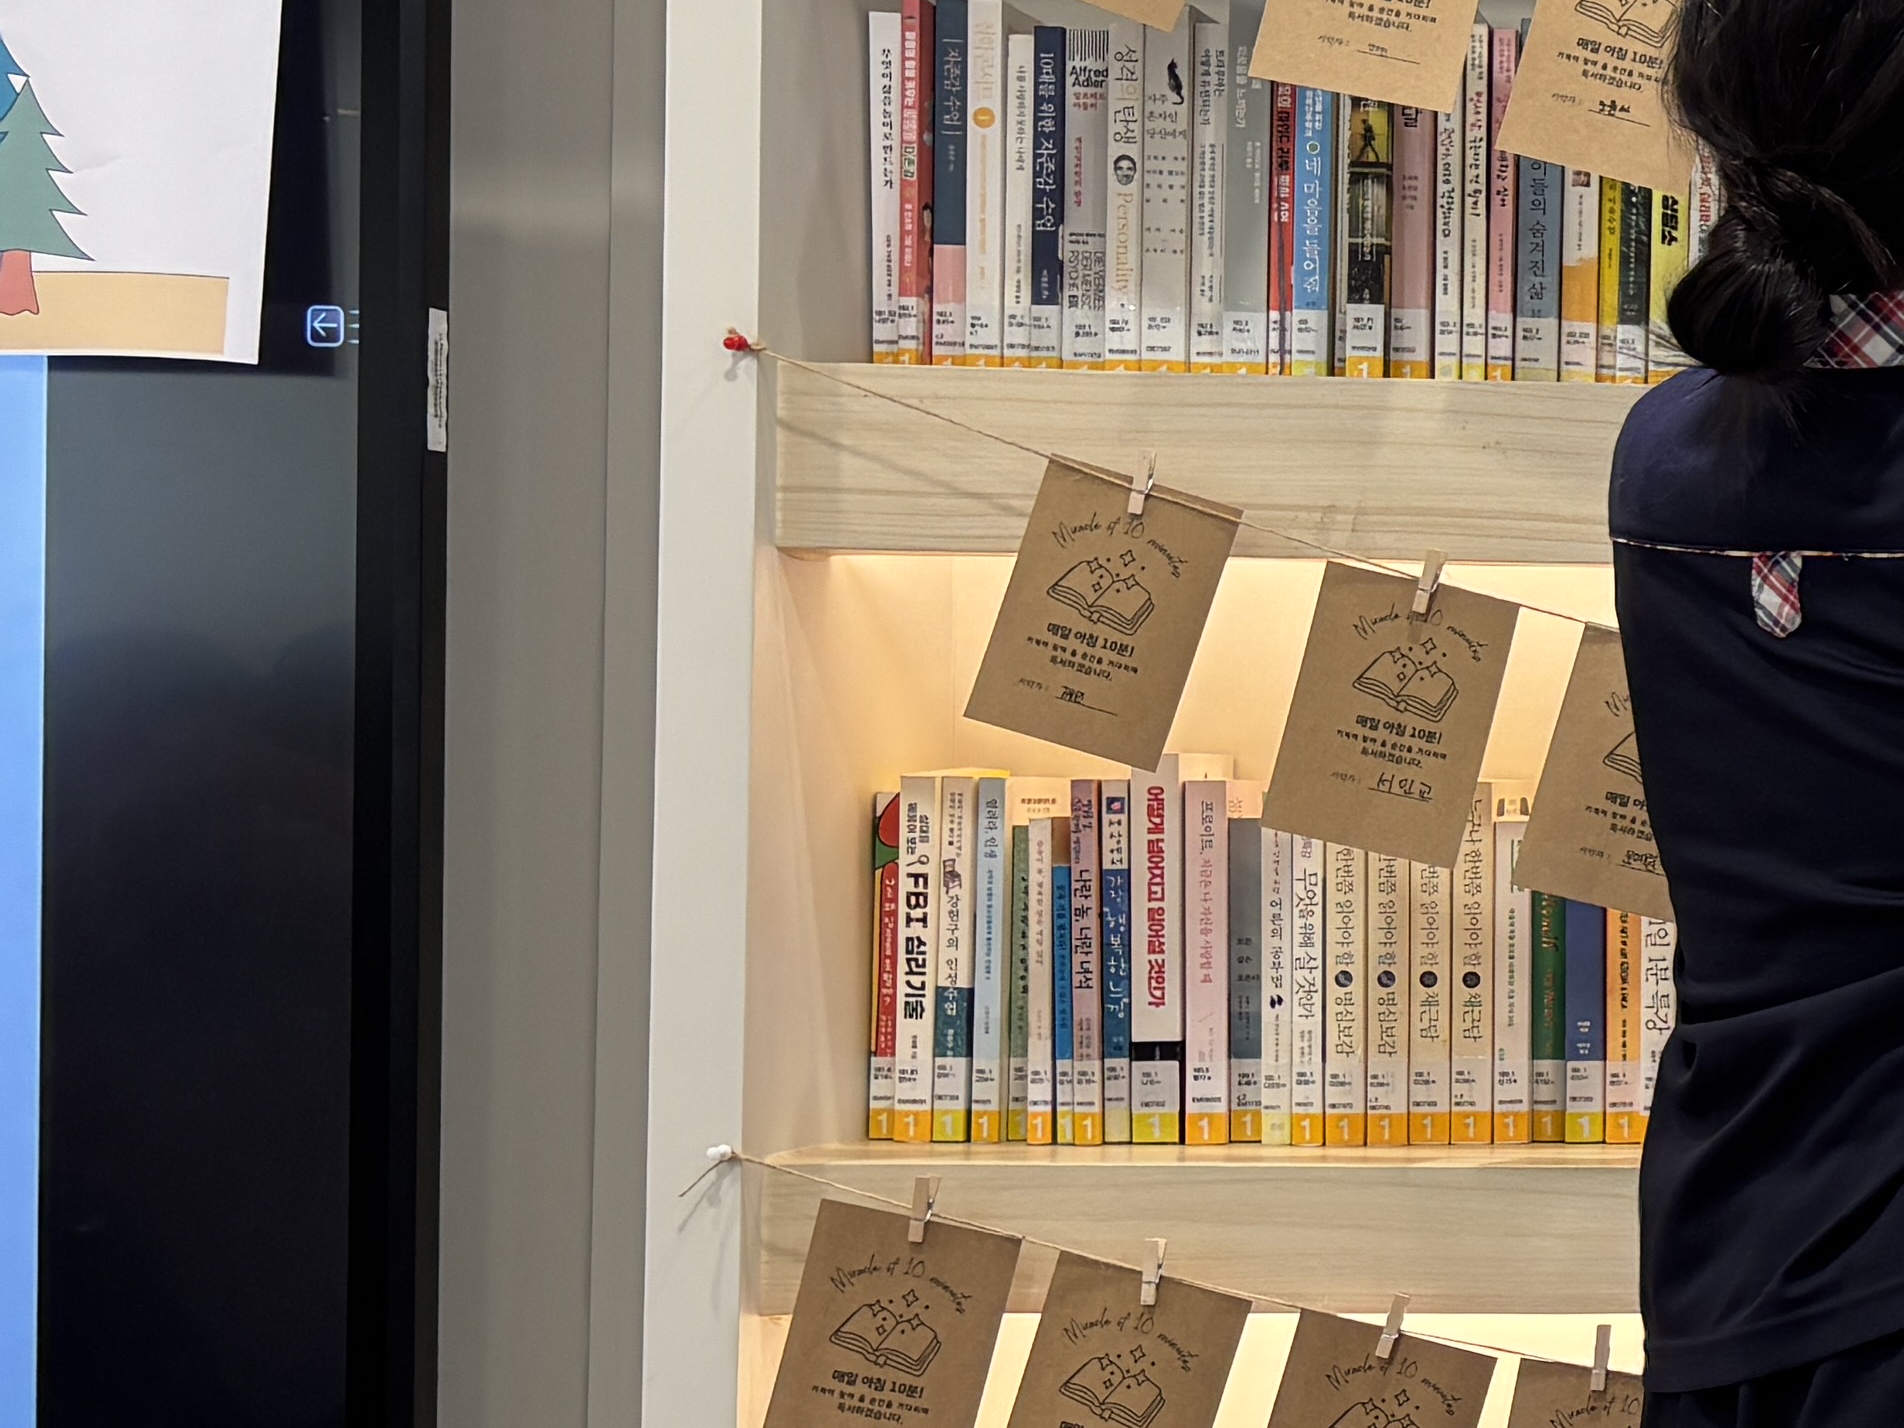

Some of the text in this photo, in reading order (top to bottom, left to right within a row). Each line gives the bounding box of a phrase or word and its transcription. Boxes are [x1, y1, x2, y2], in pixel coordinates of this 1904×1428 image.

[1036, 52, 1056, 232] 10대를 위한 자존감 수업
[1069, 66, 1107, 78] Alfred
[1071, 80, 1106, 88] Adler
[1113, 45, 1138, 144] 성격의 탄생
[904, 872, 928, 1020] FBI 심리기술
[1075, 869, 1091, 989] 나란 놈, 너란 녀석
[1147, 786, 1166, 1008] 어떻게 넘어지고 일어설 것인가
[1295, 868, 1318, 1019] 무엇을 위해 살 것인가
[1335, 849, 1354, 1057] 한번쯤 읽어야 할 명심보감
[1463, 850, 1482, 1042] 한번쯤 읽어야 할 채근담
[1300, 1116, 1311, 1138] 1
